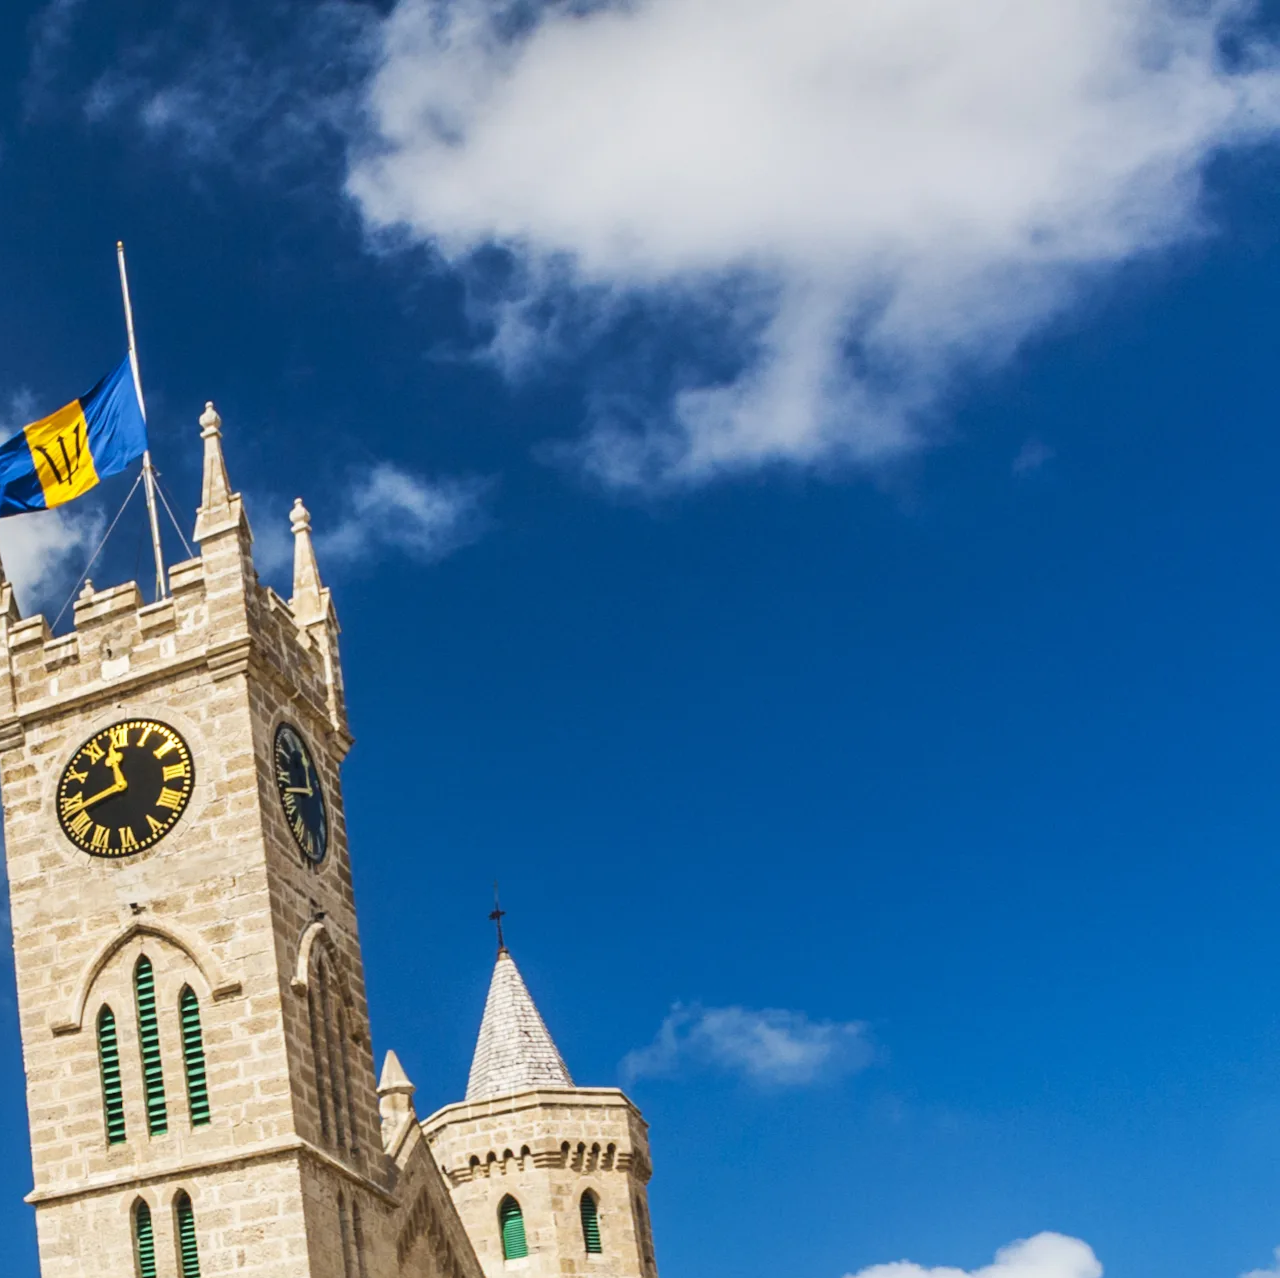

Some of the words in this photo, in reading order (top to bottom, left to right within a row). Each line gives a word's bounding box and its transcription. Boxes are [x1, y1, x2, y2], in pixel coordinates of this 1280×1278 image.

[153, 738, 177, 760] II
[162, 762, 186, 782] III
[156, 786, 183, 811] IIII
[91, 823, 111, 849] VII
[118, 825, 138, 849] VI
